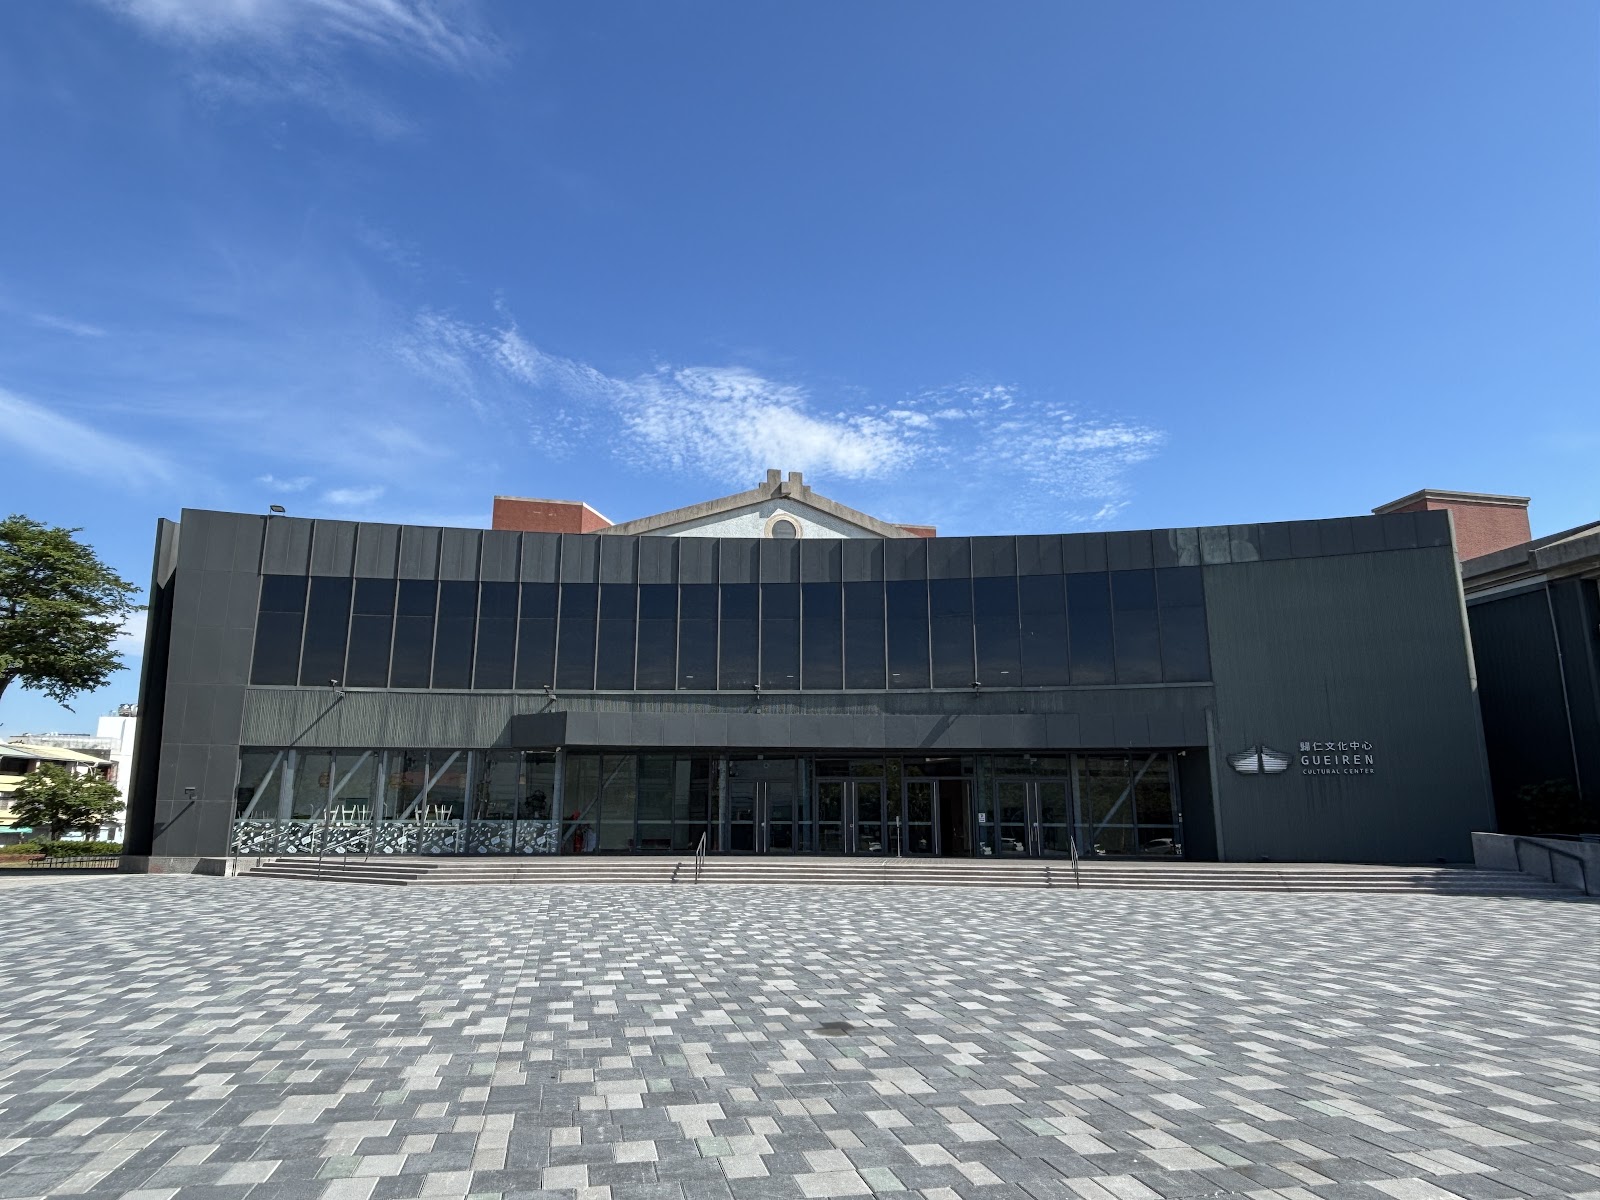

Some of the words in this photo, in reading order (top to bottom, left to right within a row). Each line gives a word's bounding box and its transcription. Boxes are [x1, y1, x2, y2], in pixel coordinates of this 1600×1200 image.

[1299, 741, 1373, 751] 歸仁文化中心
[1301, 754, 1374, 765] GUEIREN
